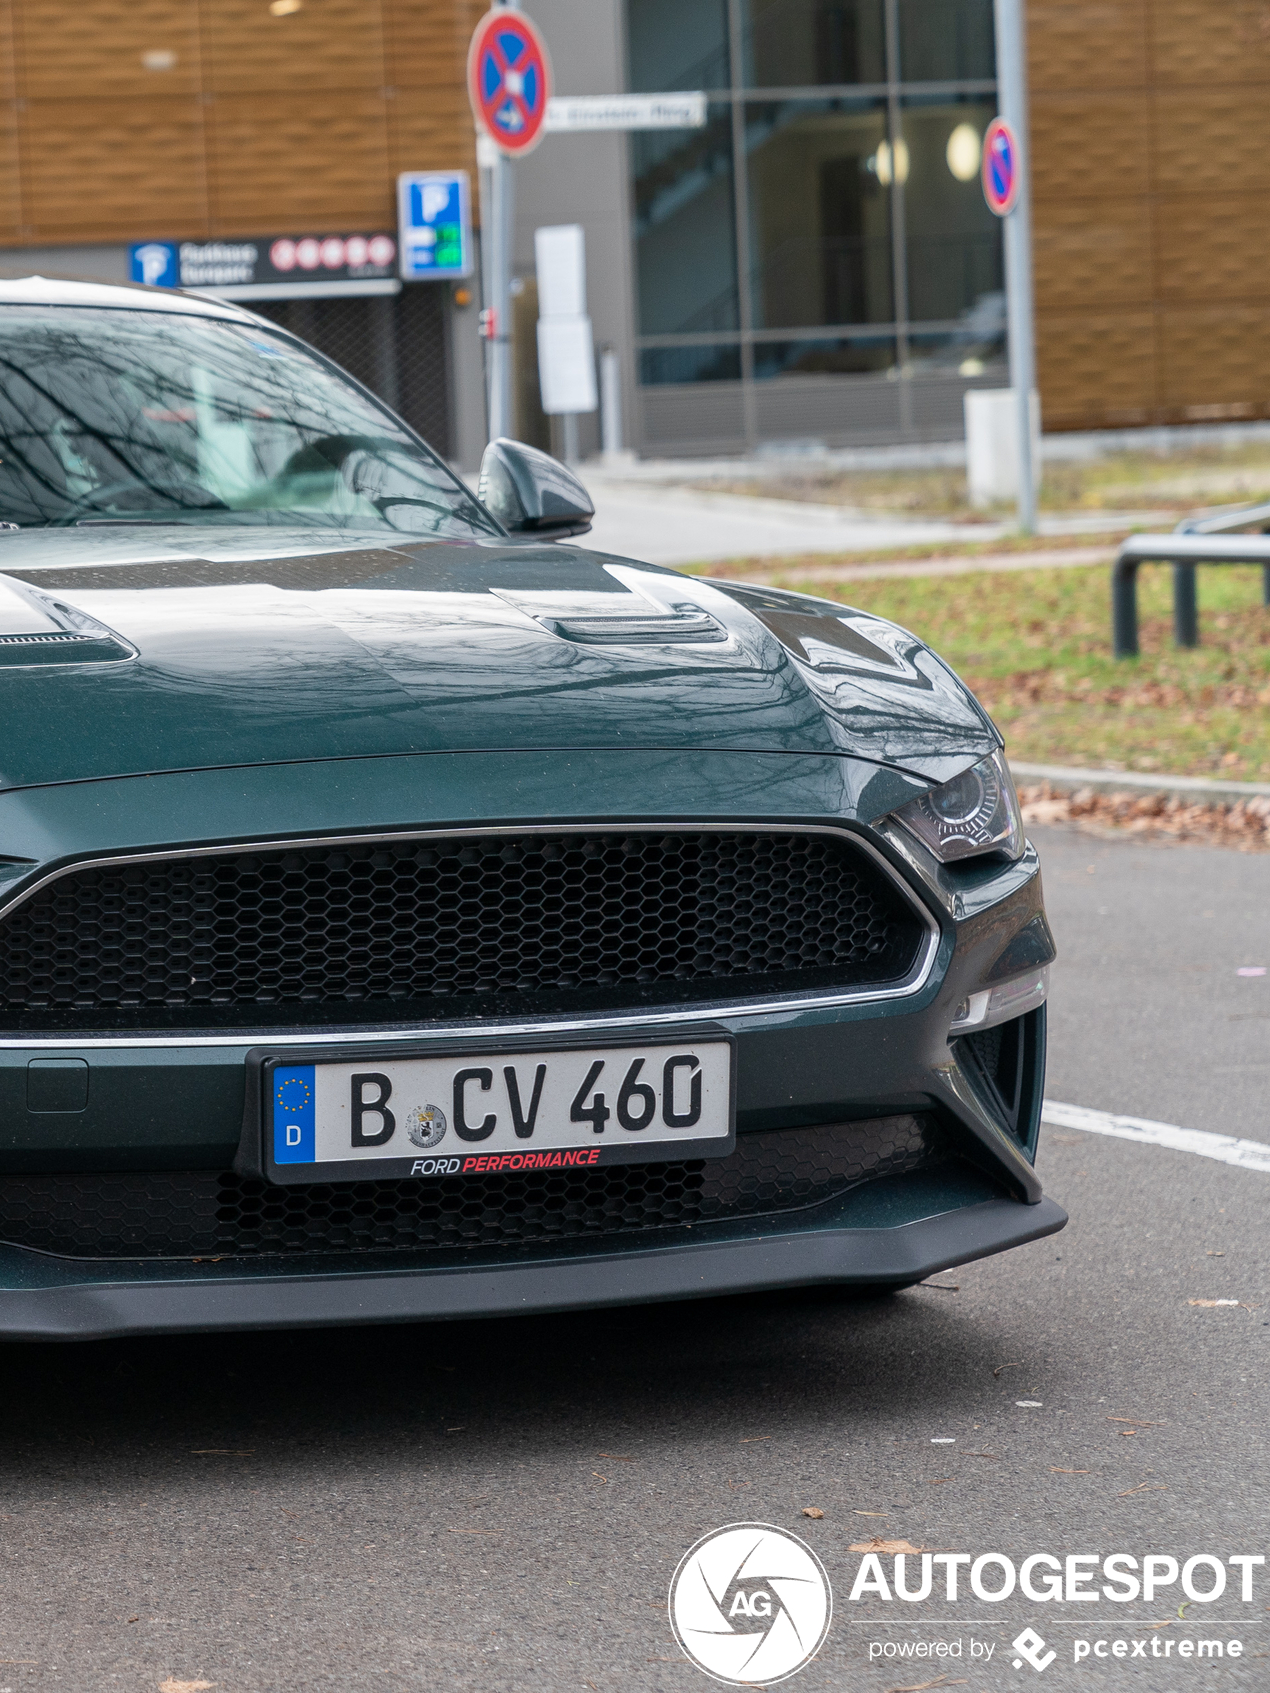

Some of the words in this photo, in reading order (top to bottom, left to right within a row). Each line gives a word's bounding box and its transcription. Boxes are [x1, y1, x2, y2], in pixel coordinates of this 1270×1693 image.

[351, 1072, 396, 1148] B
[453, 1063, 547, 1142] CV
[570, 1054, 703, 1134] 460
[286, 1125, 301, 1147] D
[411, 1158, 461, 1175] FORD
[462, 1150, 601, 1173] PERFORMANCE
